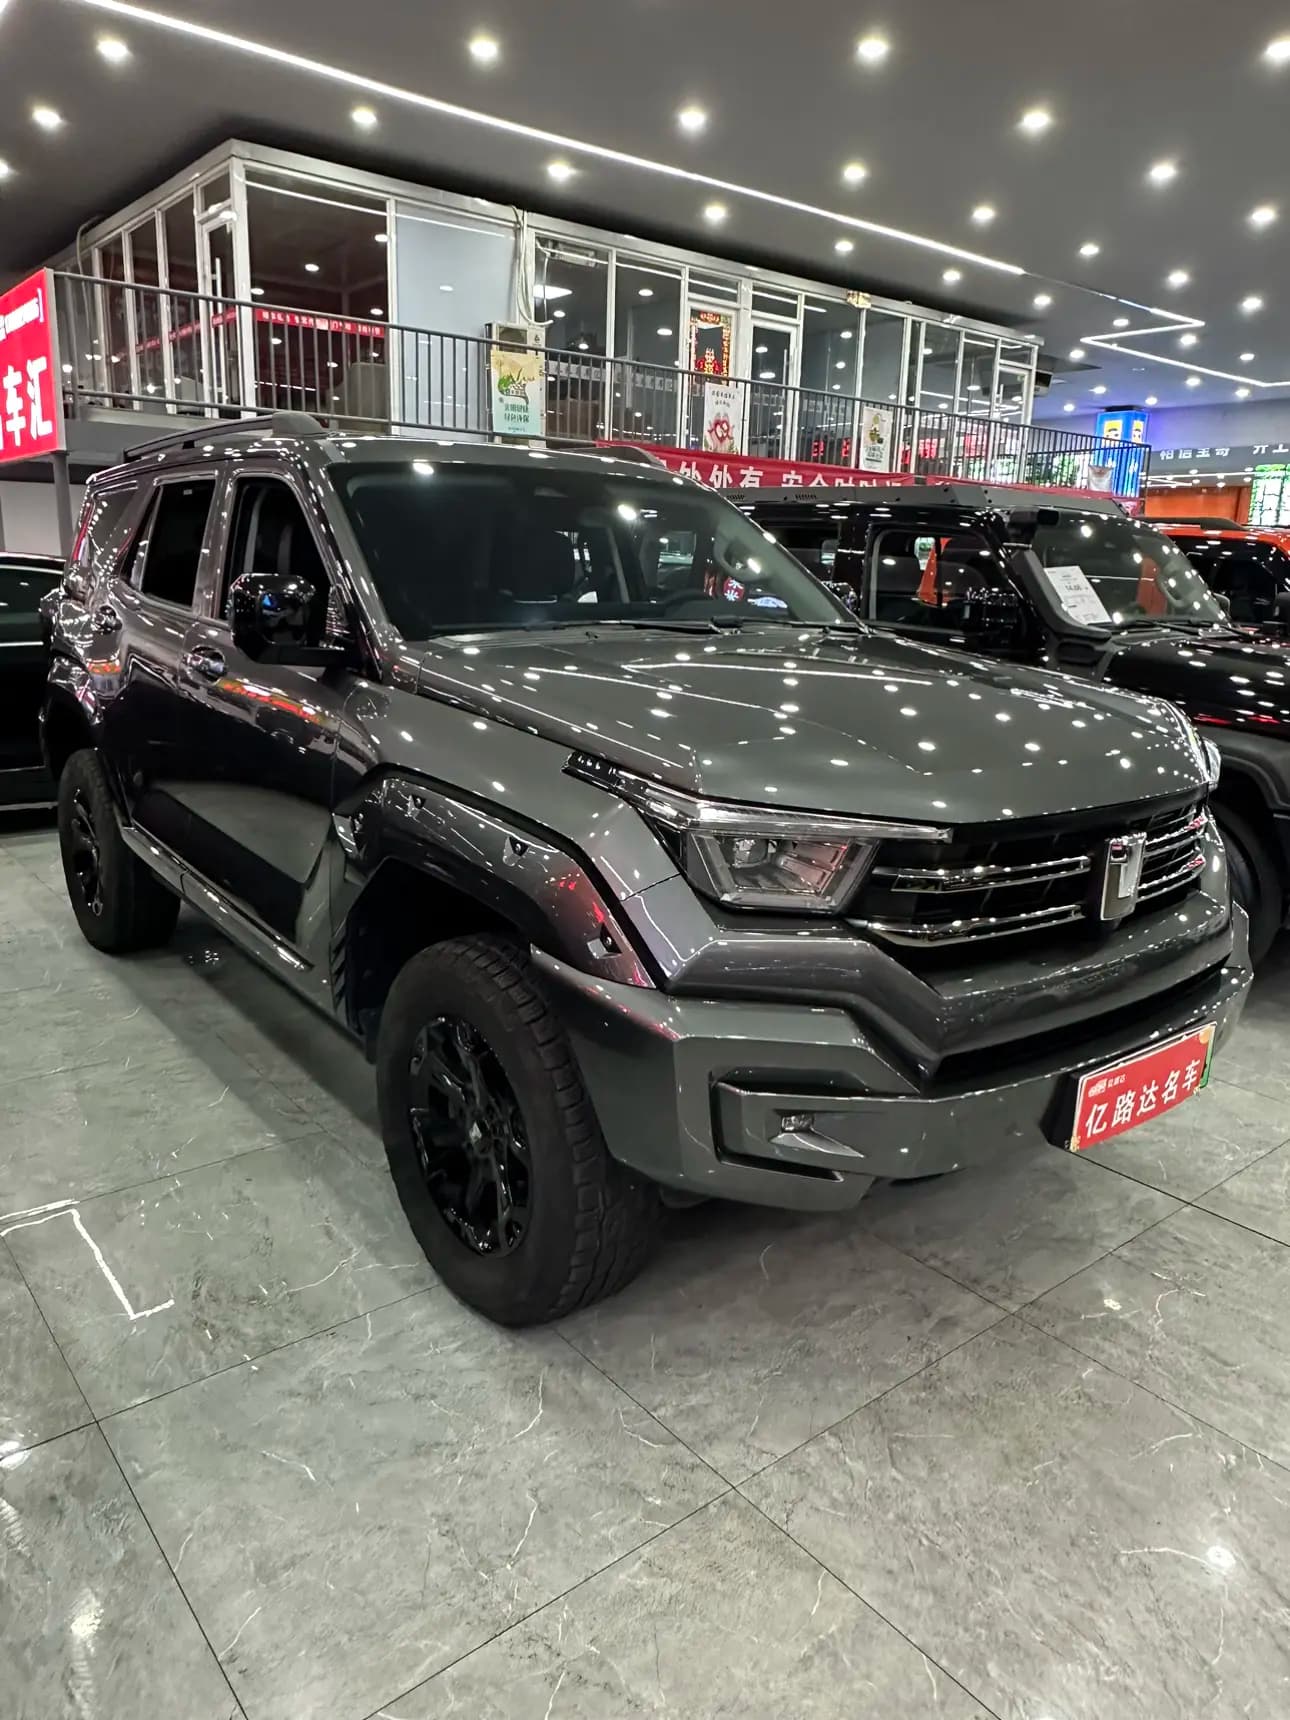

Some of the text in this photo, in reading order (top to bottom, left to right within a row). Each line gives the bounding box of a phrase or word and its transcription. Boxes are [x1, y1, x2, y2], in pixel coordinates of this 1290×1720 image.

[0, 357, 52, 450] 车汇
[1085, 1059, 1201, 1138] 亿路达名车
